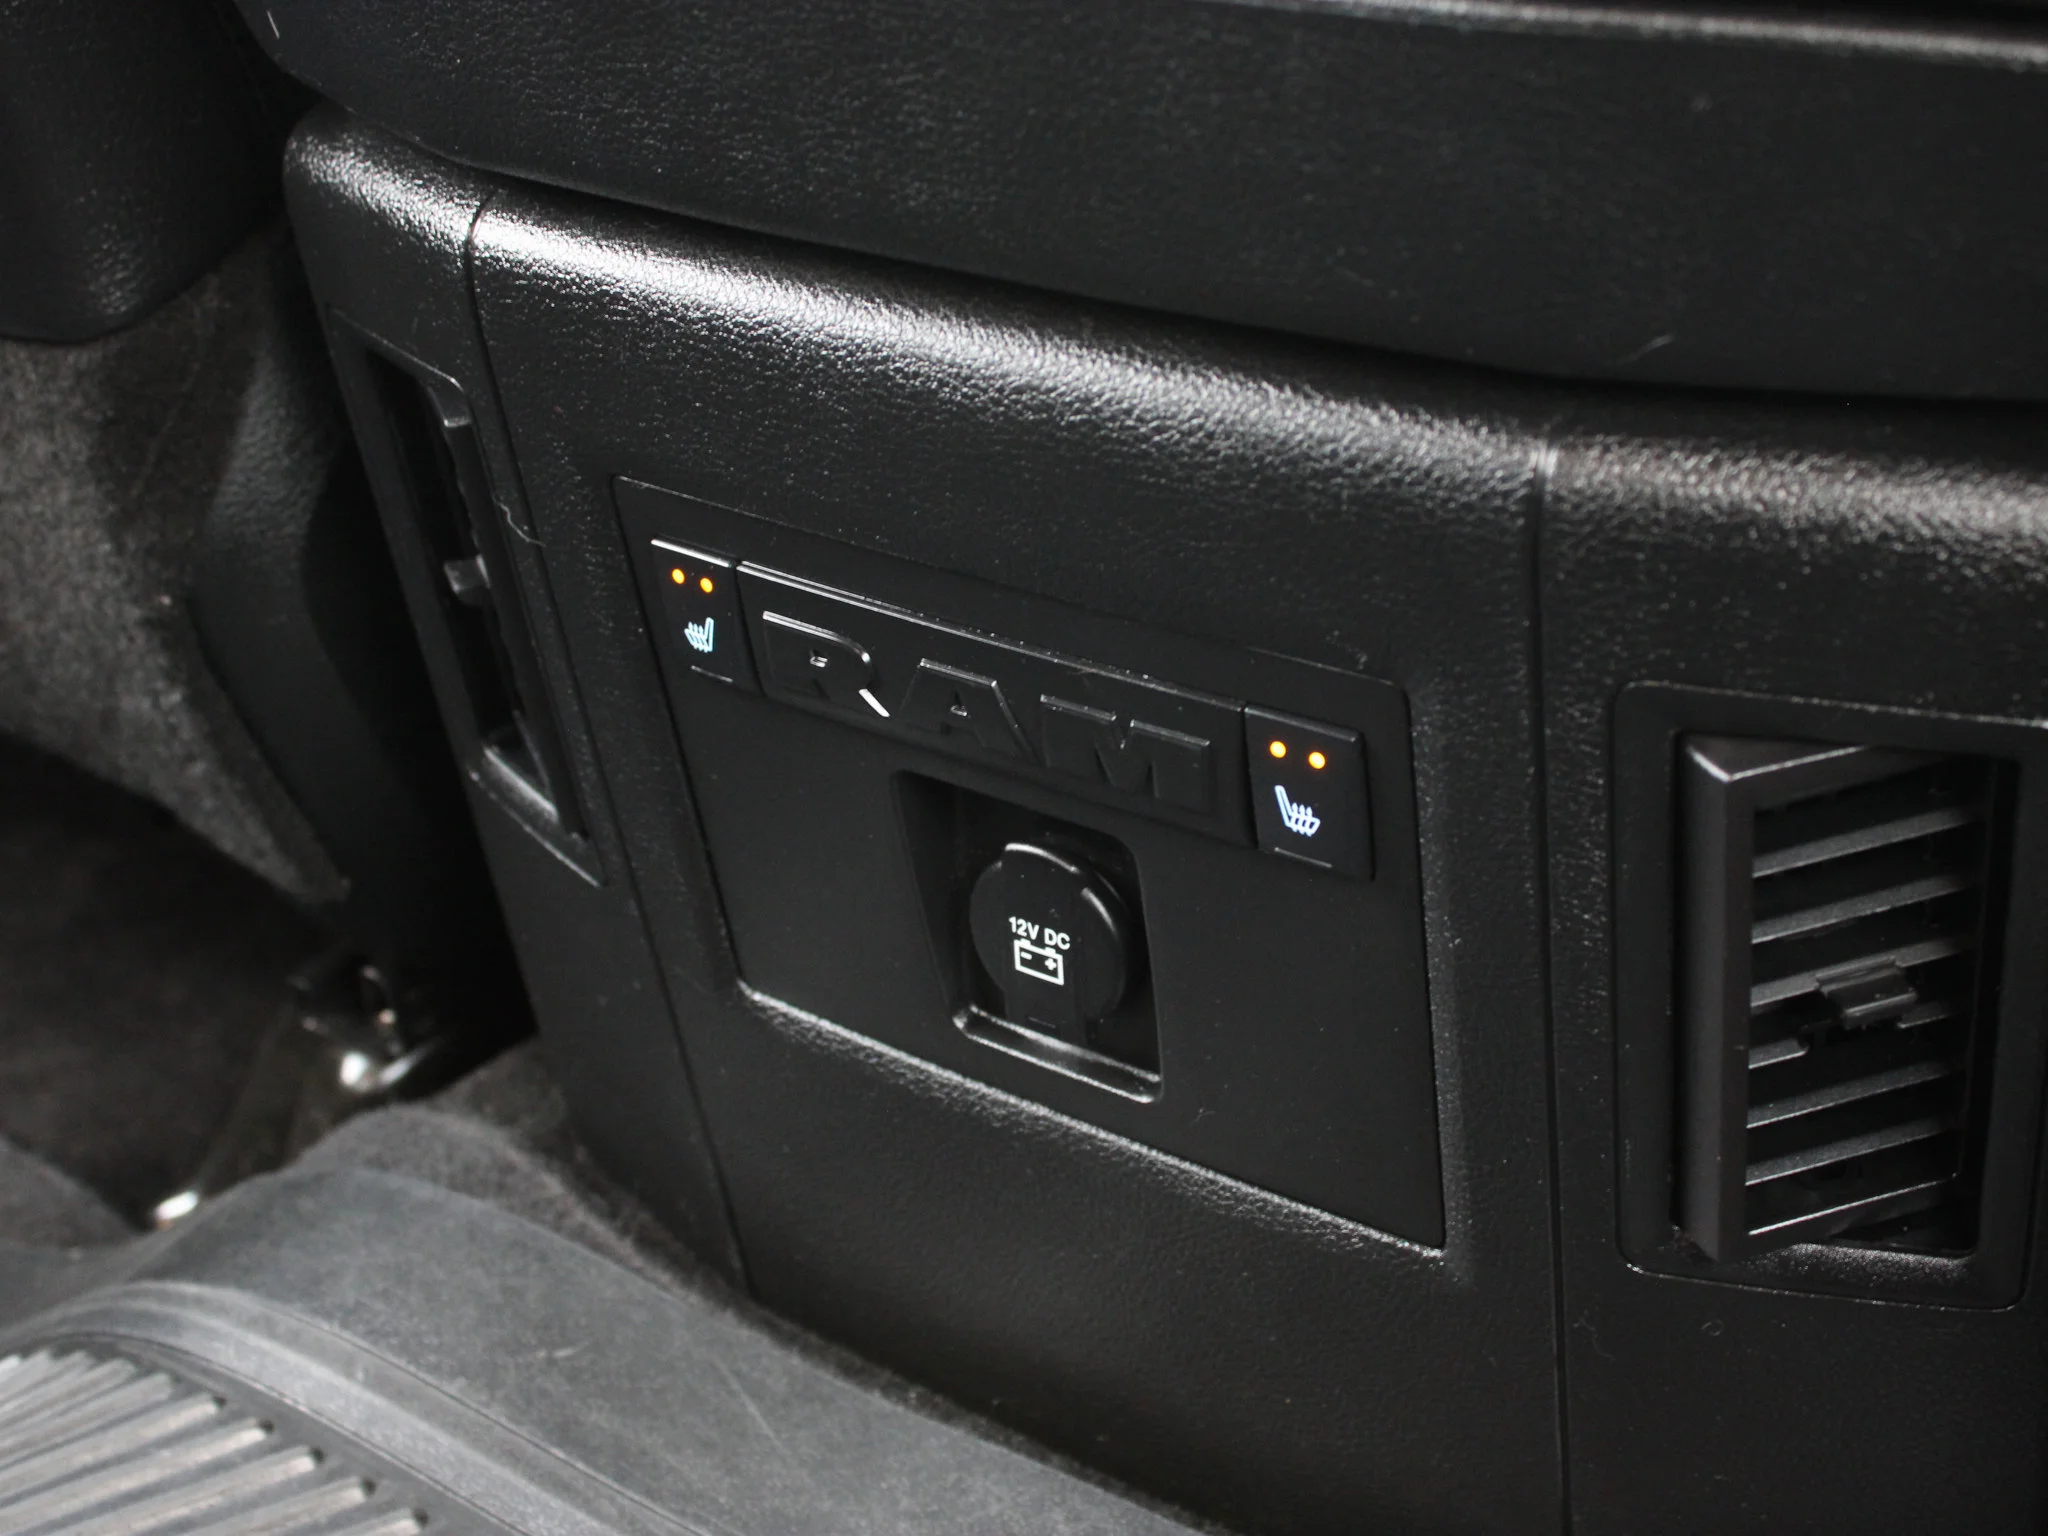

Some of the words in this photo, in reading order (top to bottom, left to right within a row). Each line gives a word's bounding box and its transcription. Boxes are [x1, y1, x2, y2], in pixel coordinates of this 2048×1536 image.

[761, 609, 1211, 806] RAM
[1008, 916, 1040, 940] 12V
[1043, 927, 1071, 950] DC
